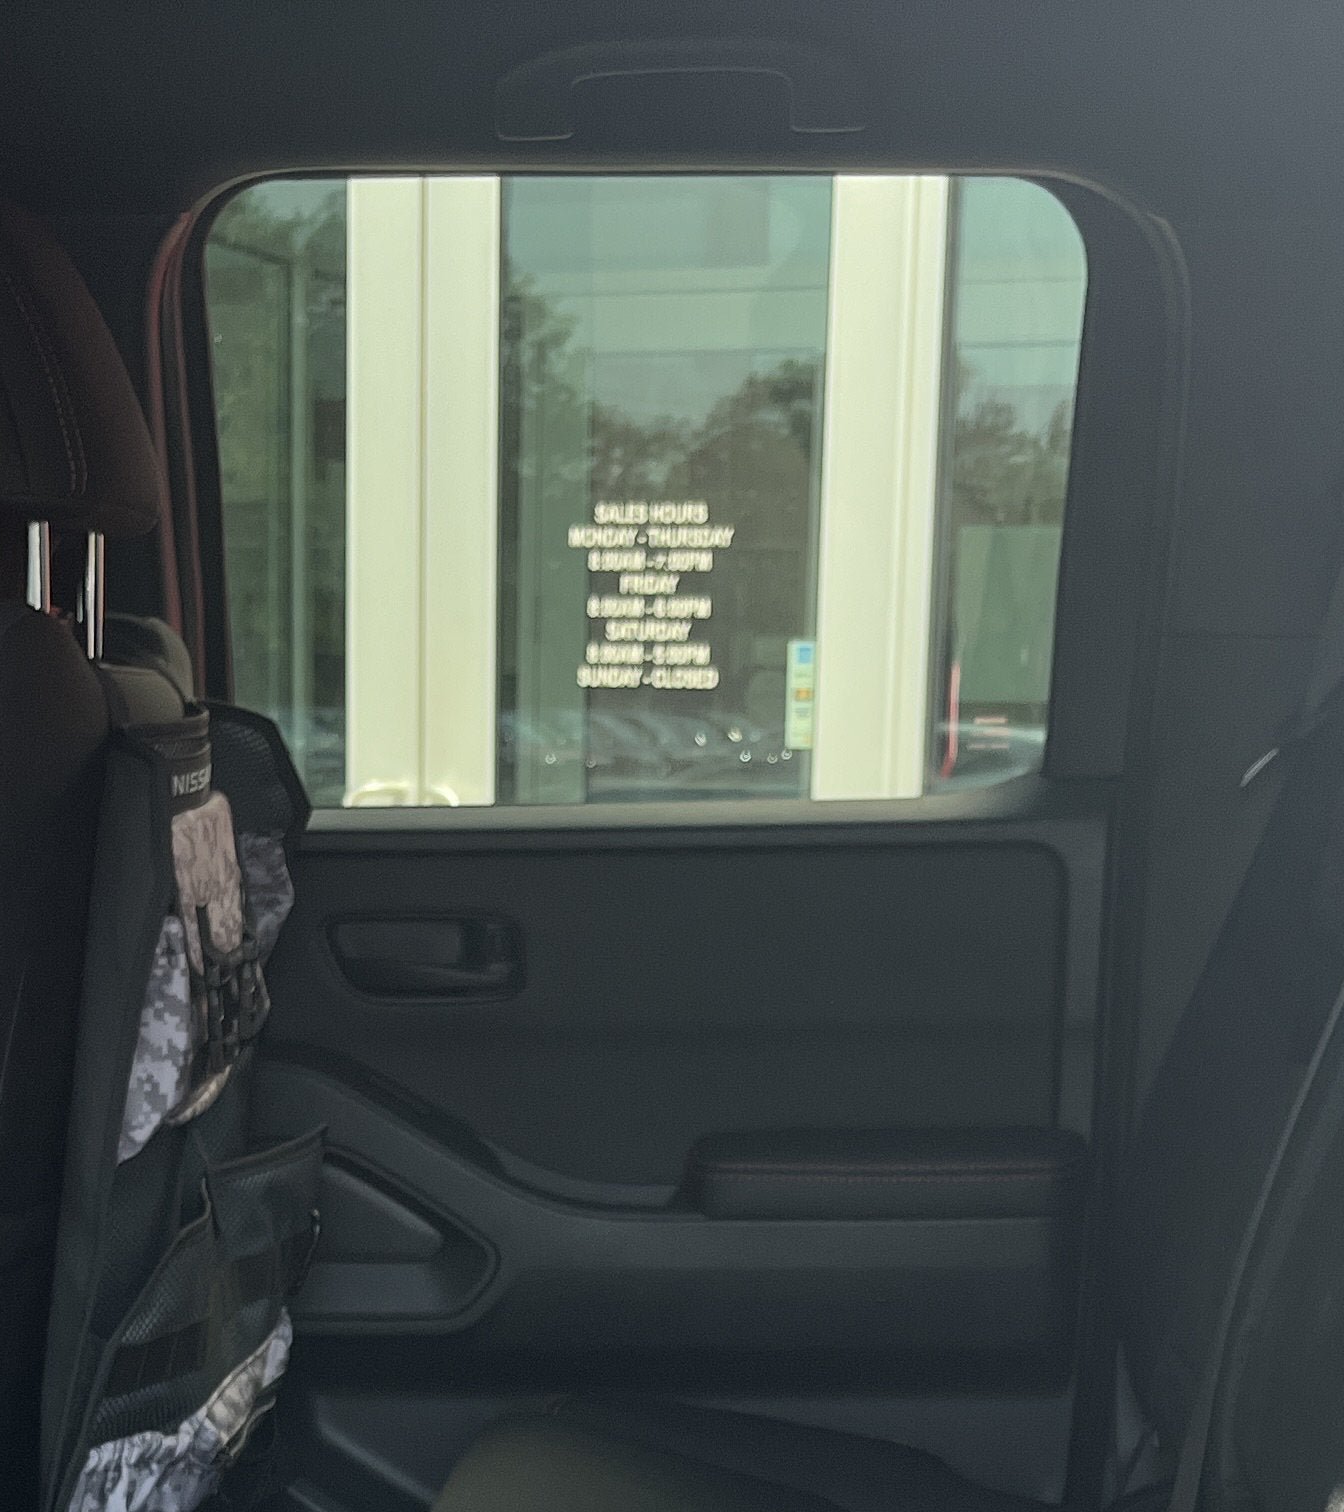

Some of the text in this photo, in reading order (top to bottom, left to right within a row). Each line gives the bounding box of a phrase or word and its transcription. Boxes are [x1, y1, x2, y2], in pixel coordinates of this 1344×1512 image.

[594, 499, 708, 524] SALES HOURS
[568, 523, 638, 548] MONDAY
[647, 523, 734, 547] THURSDAY
[619, 573, 680, 595] FRIDAY
[605, 619, 692, 642] SATURDAY
[576, 665, 643, 688] SUNDAY
[651, 665, 719, 689] CLOSED
